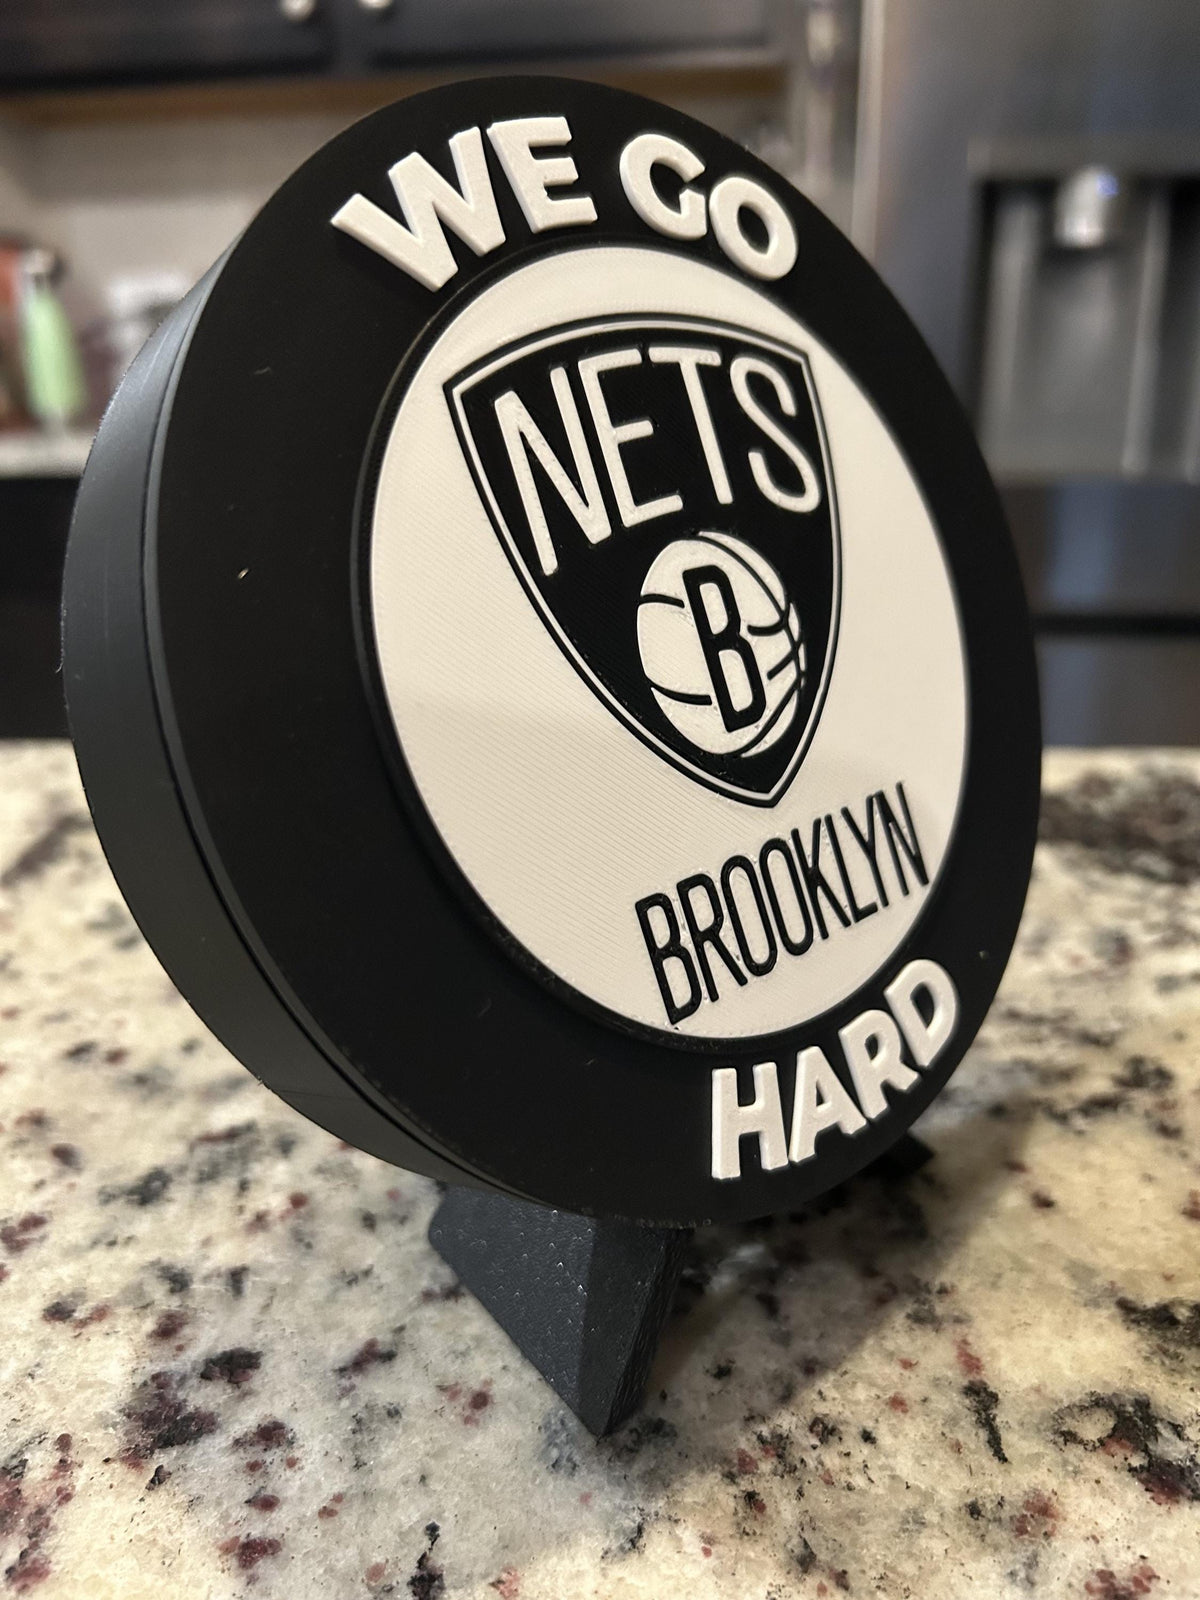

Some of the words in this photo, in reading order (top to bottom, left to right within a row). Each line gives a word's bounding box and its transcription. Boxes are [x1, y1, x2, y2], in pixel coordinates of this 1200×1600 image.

[331, 115, 598, 292] WE
[618, 132, 798, 280] GO
[493, 345, 821, 577] NETS
[682, 564, 766, 733] B
[634, 782, 930, 1026] BROOKLYN
[710, 958, 960, 1181] HARD
